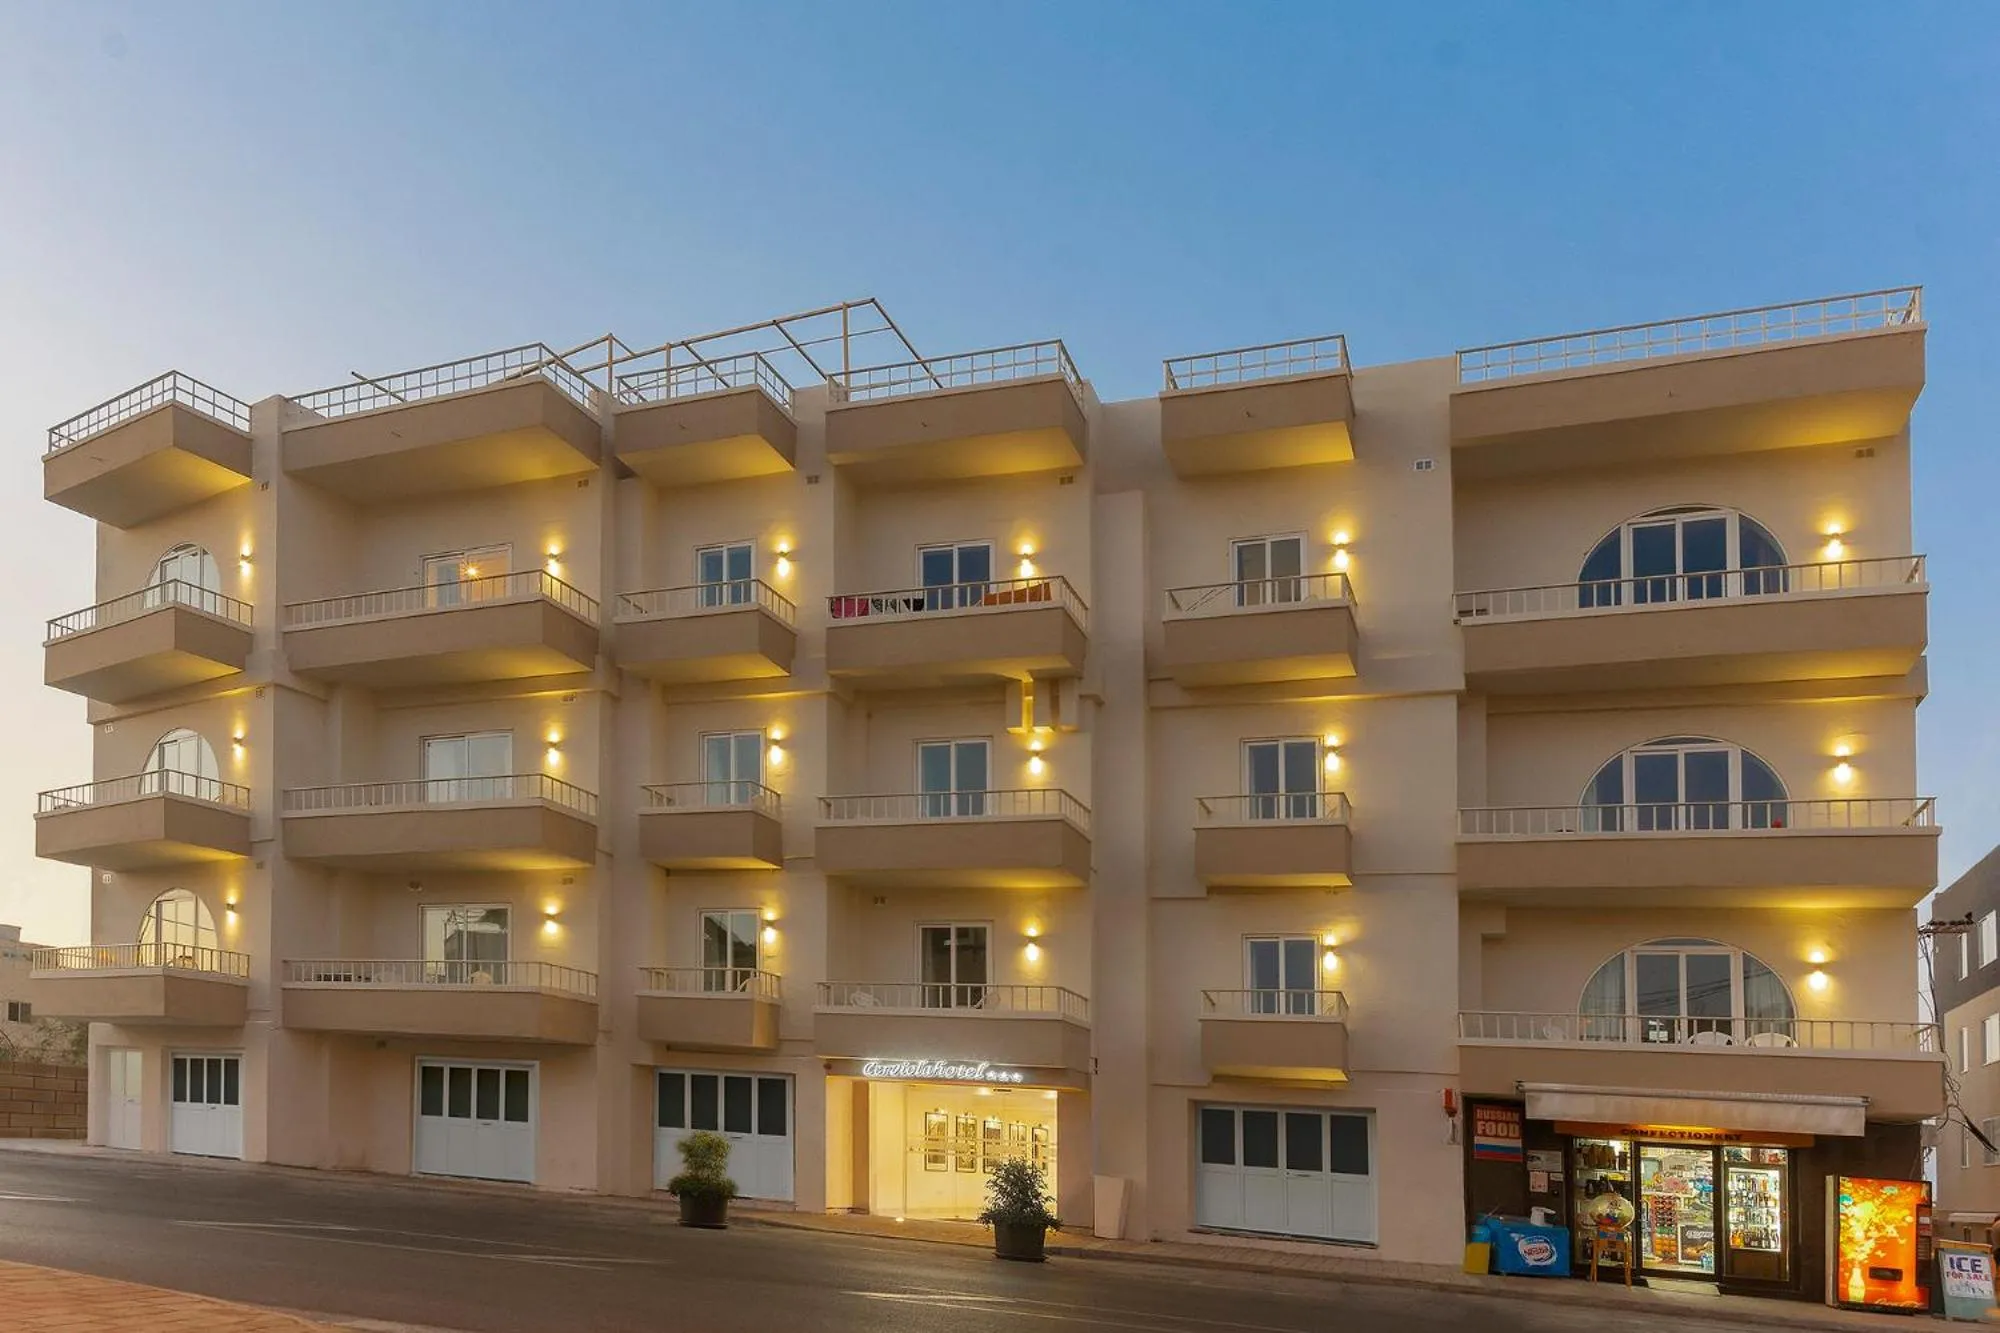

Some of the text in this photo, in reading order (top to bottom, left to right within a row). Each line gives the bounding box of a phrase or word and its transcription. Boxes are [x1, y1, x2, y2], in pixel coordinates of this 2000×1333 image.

[1476, 1108, 1519, 1122] RUSSIAN
[1477, 1120, 1520, 1138] FOOD
[1621, 1128, 1742, 1141] CONFECTIONERY
[1949, 1256, 1983, 1273] ICE
[1946, 1270, 1991, 1281] FOR SALE
